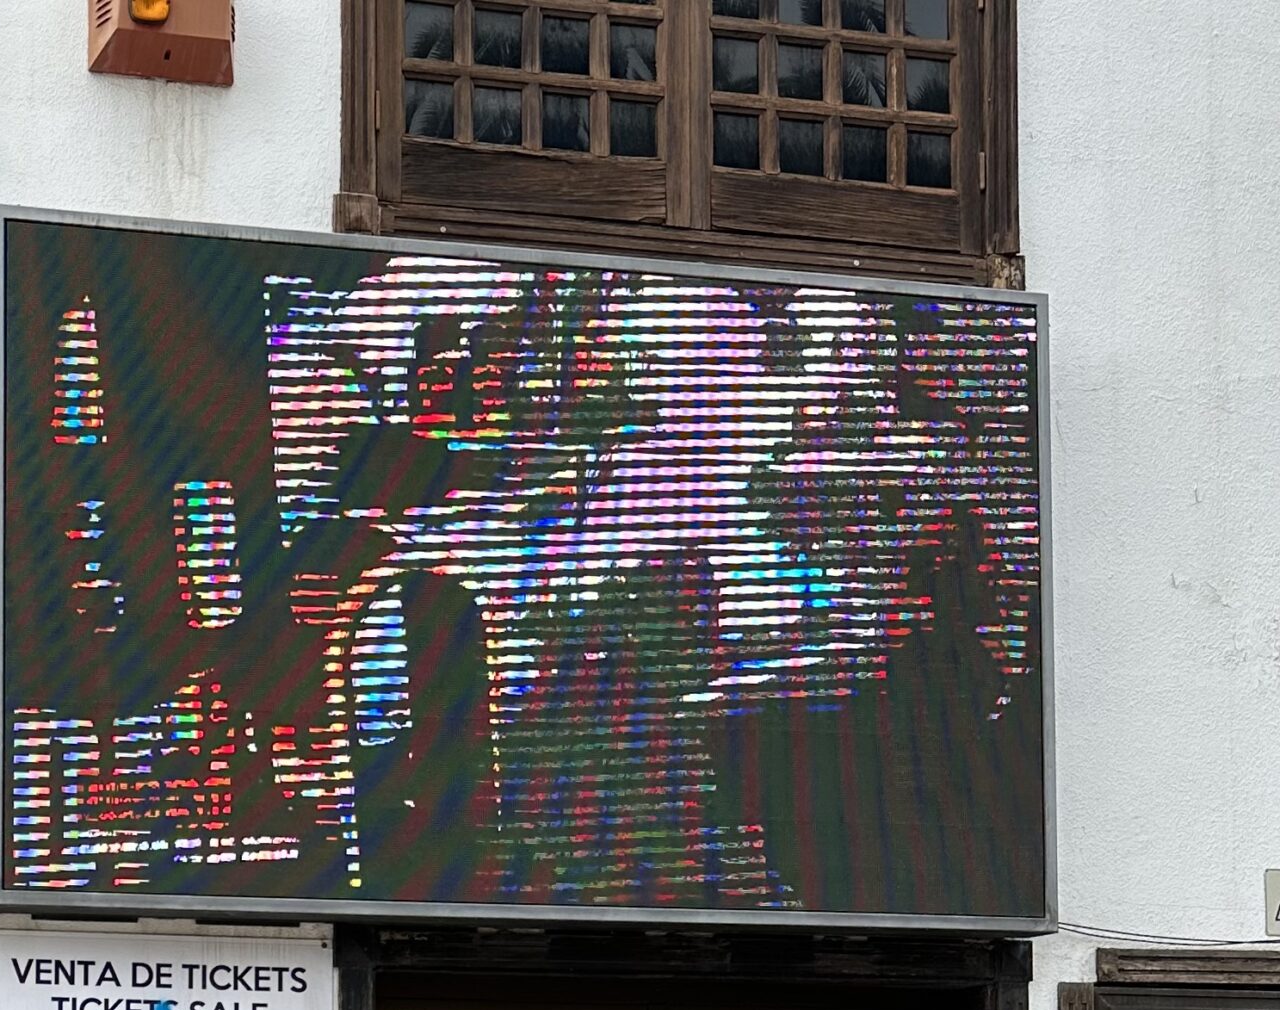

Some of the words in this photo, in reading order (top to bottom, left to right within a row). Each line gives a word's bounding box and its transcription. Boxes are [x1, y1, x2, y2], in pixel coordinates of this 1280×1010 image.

[12, 958, 121, 987] VENTA
[132, 963, 172, 989] DE
[182, 964, 307, 993] TICKETS
